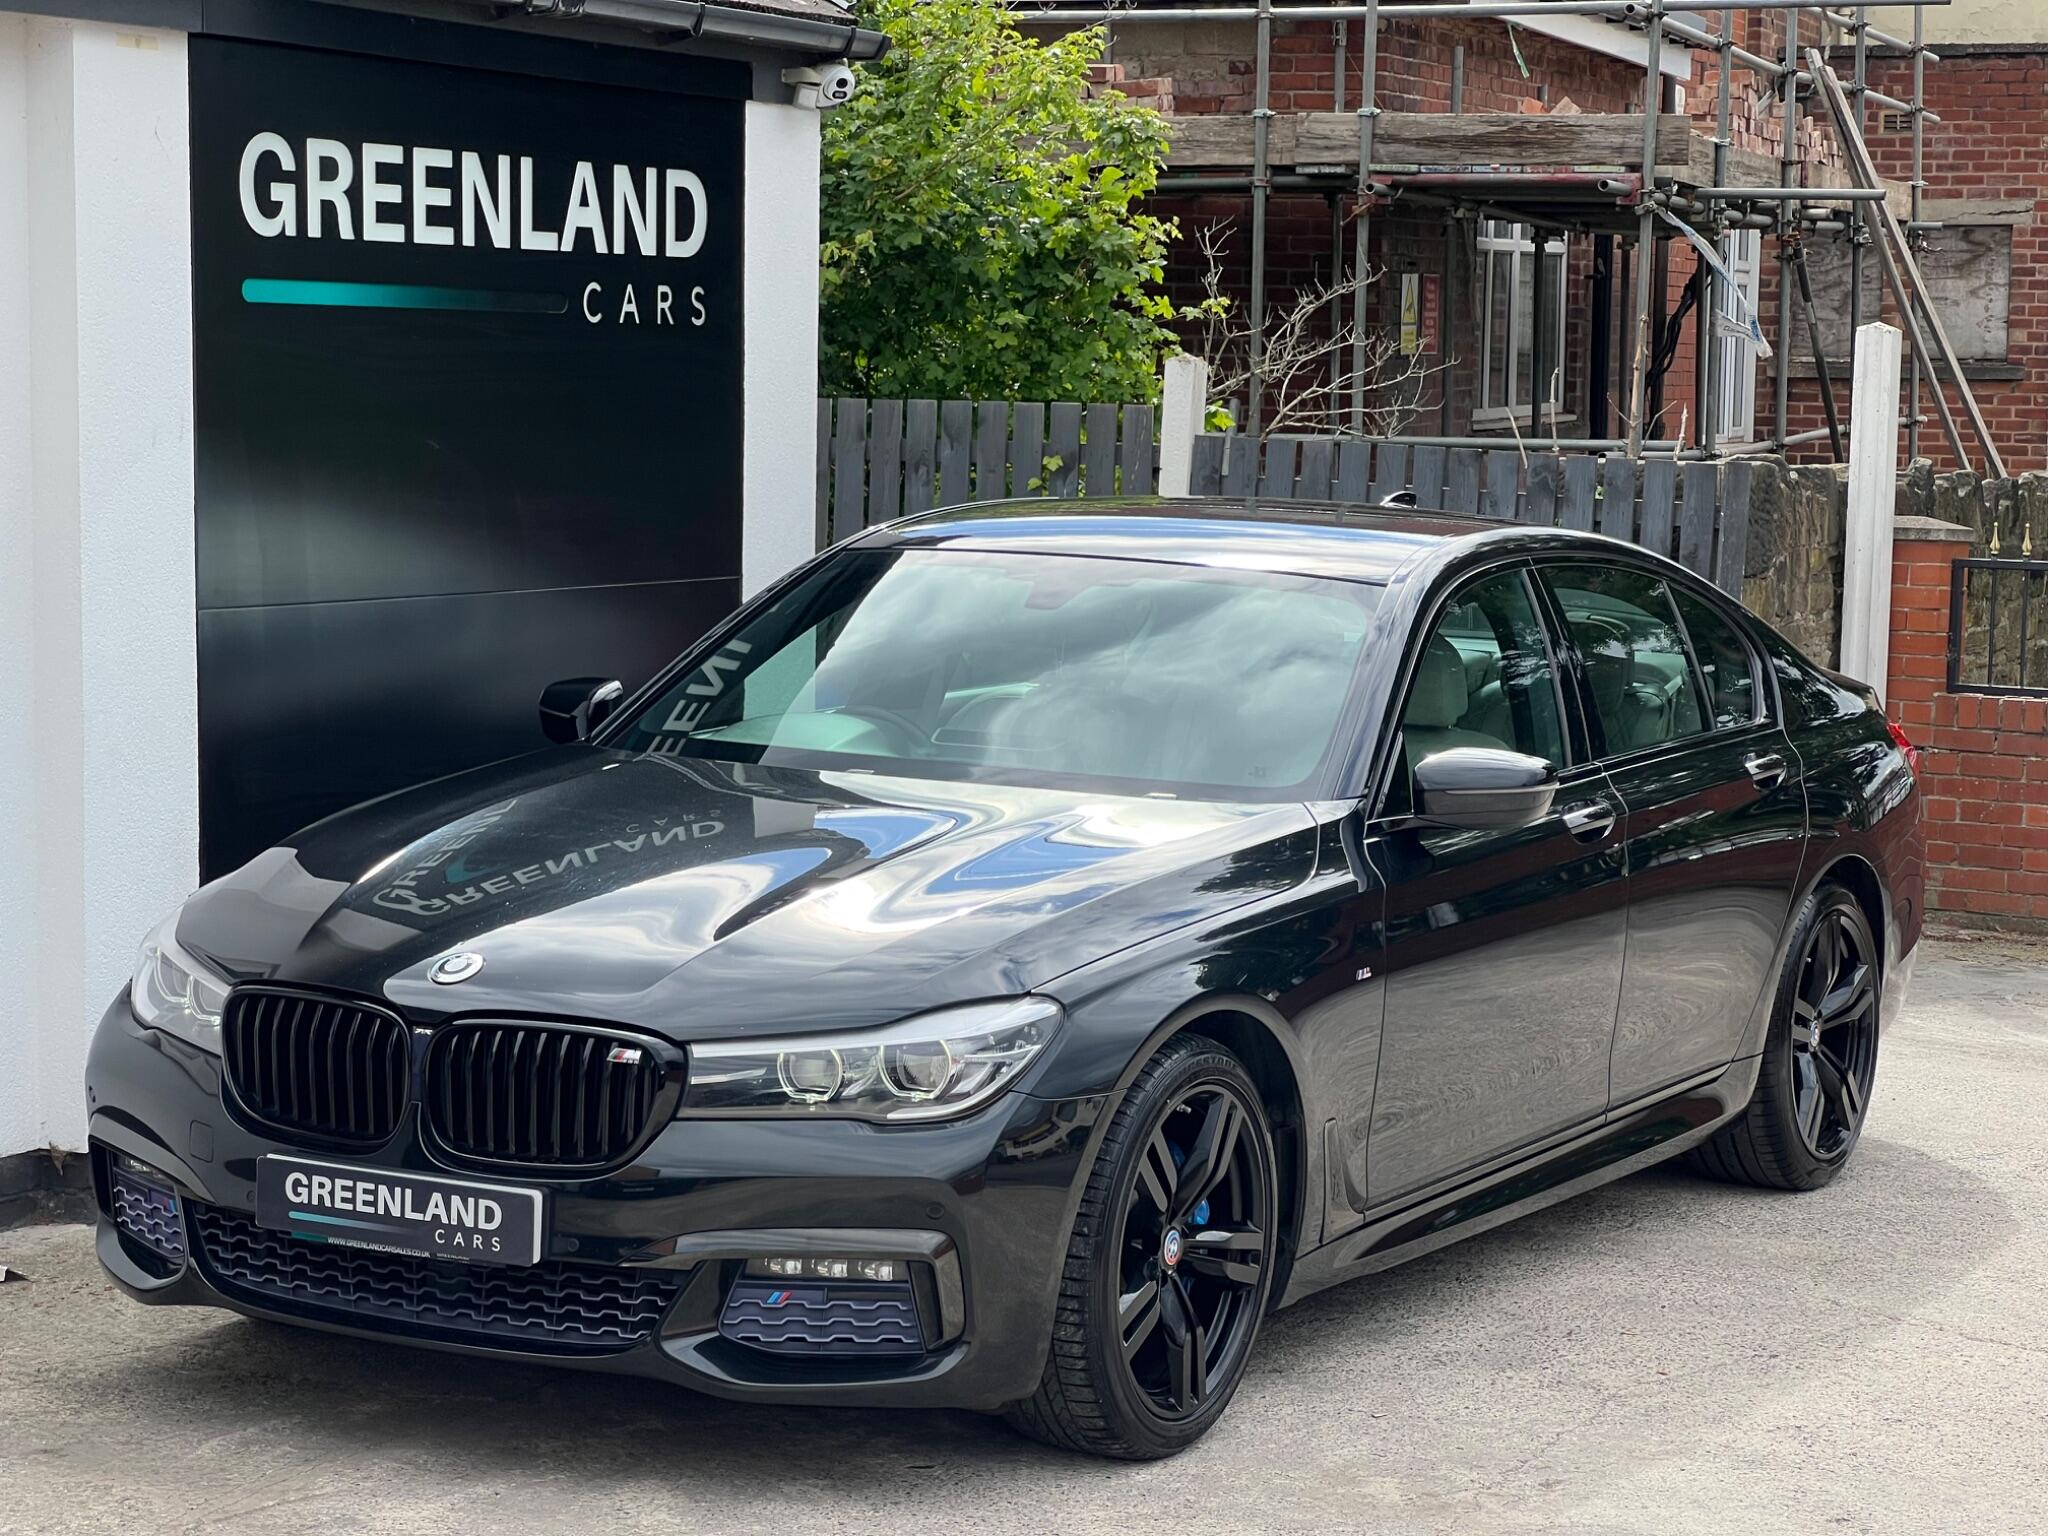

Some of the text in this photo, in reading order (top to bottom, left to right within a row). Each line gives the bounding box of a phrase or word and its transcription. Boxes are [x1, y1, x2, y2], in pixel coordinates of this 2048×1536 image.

[239, 131, 708, 258] GREENLAND
[582, 281, 707, 326] CARS
[285, 1171, 503, 1231] GREENLAND
[434, 1229, 501, 1252] CARS
